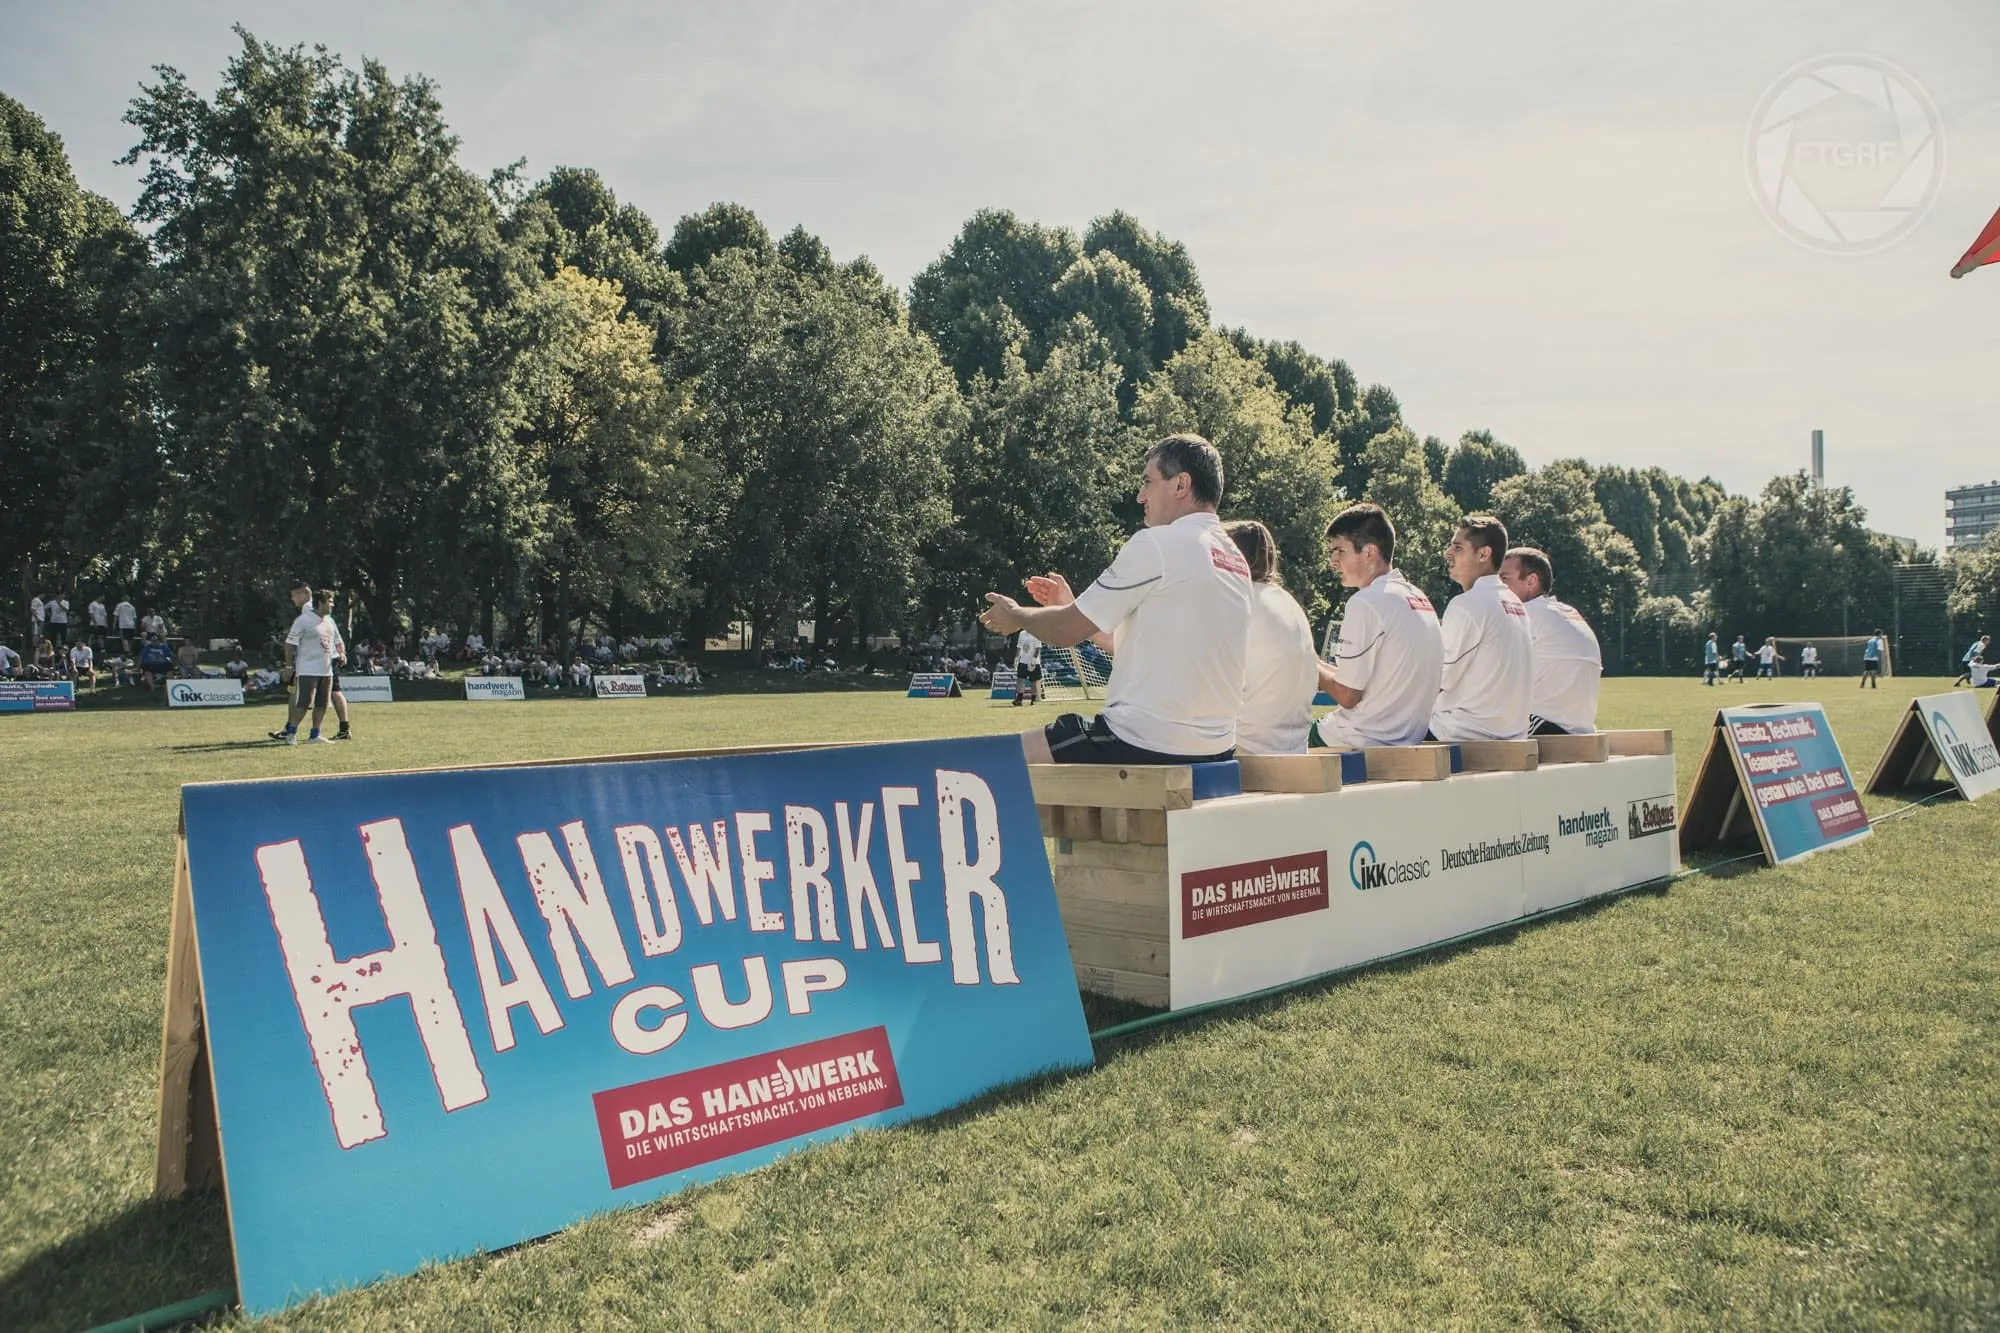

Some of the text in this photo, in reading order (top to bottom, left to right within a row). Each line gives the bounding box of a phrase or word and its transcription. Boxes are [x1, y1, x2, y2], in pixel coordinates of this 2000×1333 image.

[202, 692, 241, 702] classic
[1767, 716, 1816, 740] Technik,
[1784, 776, 1807, 797] wie
[1803, 770, 1826, 792] bei
[1642, 801, 1674, 828] Rothaus
[1585, 826, 1619, 848] magazin
[1387, 855, 1430, 886] classic
[1191, 883, 1227, 907] DAS
[1192, 886, 1322, 921] DIE WIRTSCHAFTSMACHT. VON NEBENAN.
[611, 955, 848, 1055] CUP
[619, 1096, 693, 1140] DAS
[626, 1076, 888, 1160] DIE WIRTSCHAFTSMACHT. VON NEBENAN.
